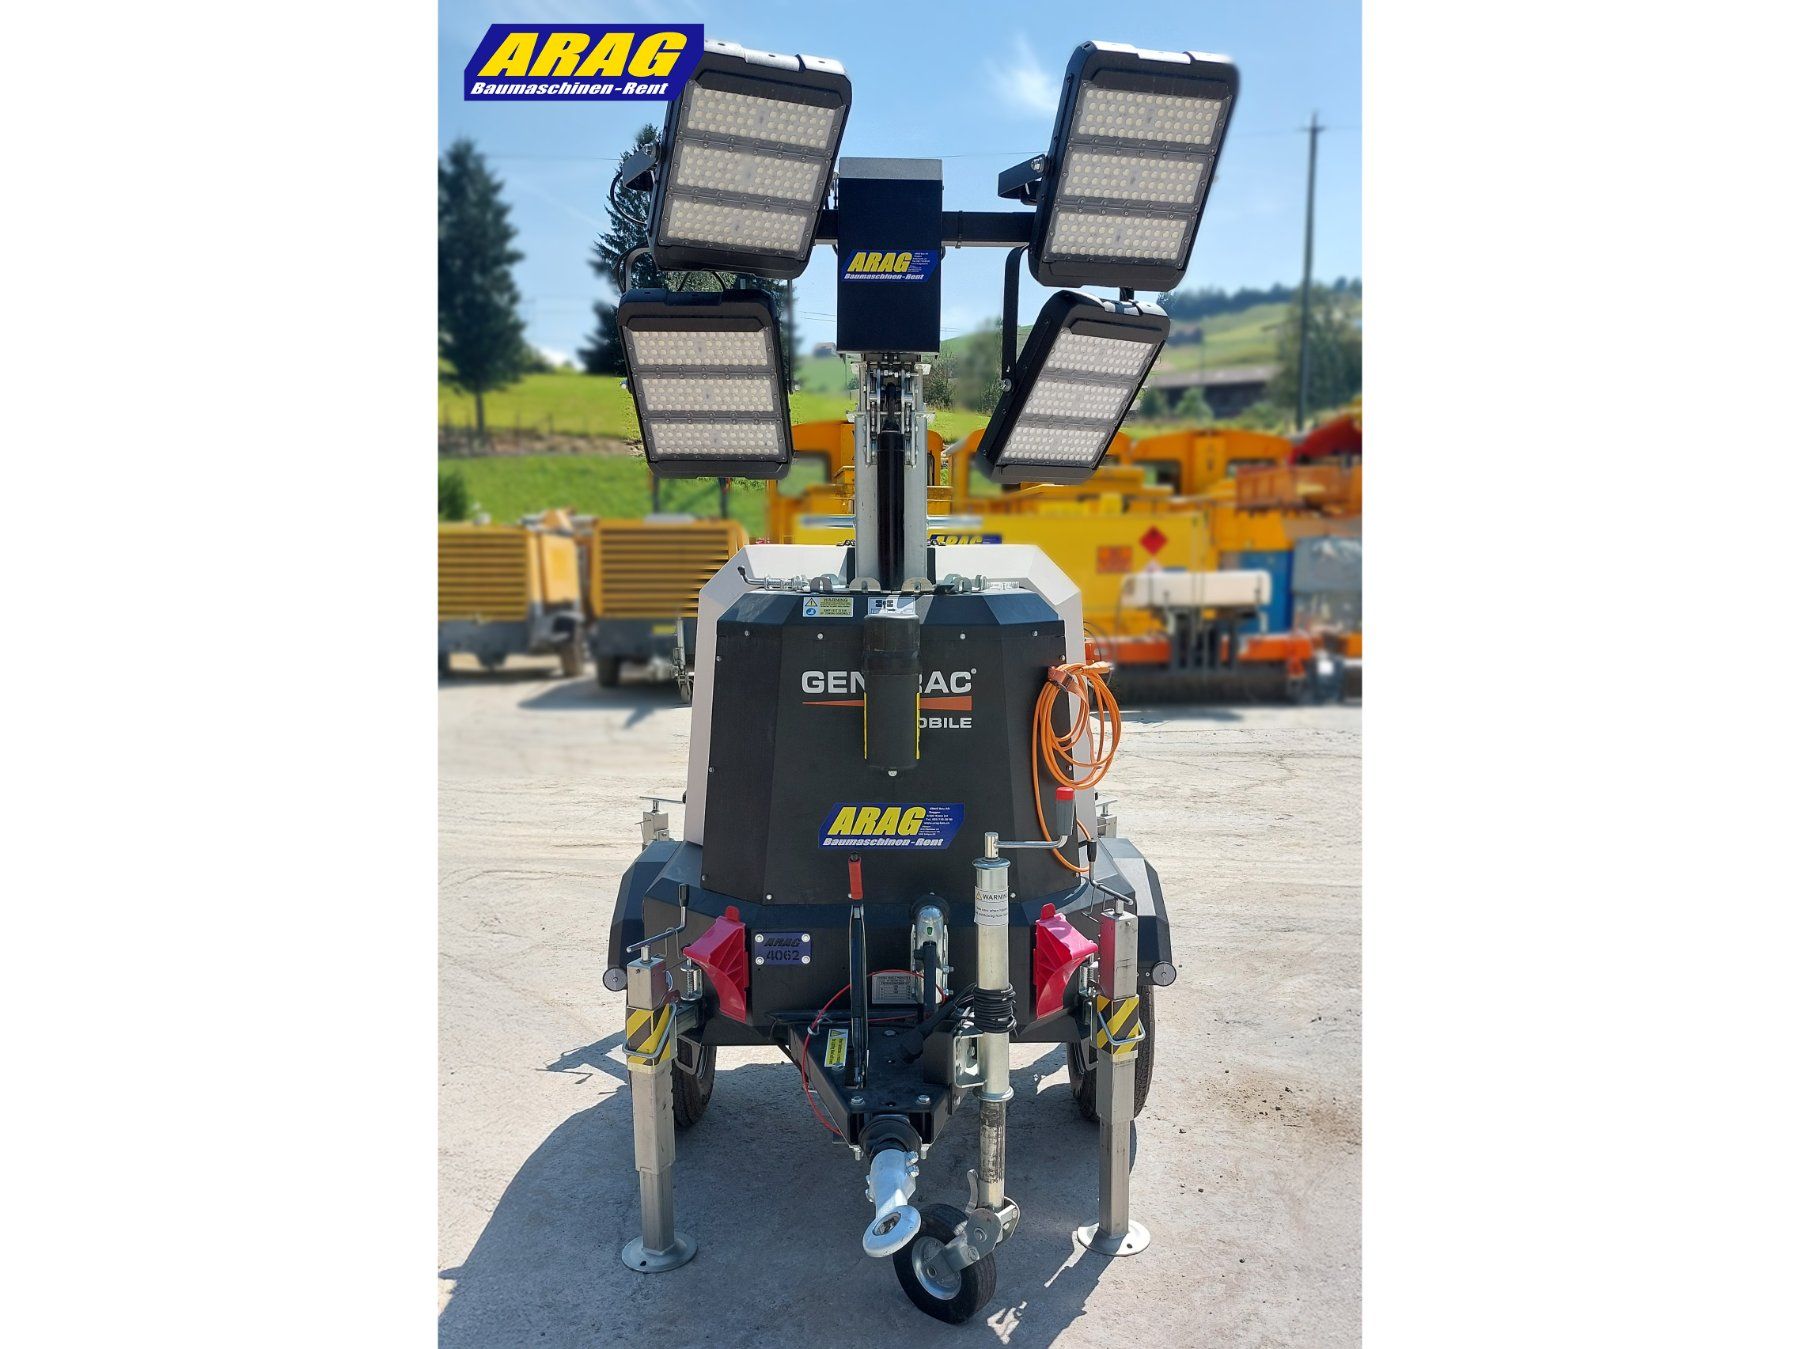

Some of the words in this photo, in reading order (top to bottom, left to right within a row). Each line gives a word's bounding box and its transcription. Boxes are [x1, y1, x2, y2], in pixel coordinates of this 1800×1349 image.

[847, 252, 912, 272] ARAG
[801, 671, 972, 694] GENAC
[919, 717, 972, 729] OBILE
[827, 806, 926, 836] ARAG
[764, 937, 801, 947] ARAG
[766, 949, 800, 961] 4062
